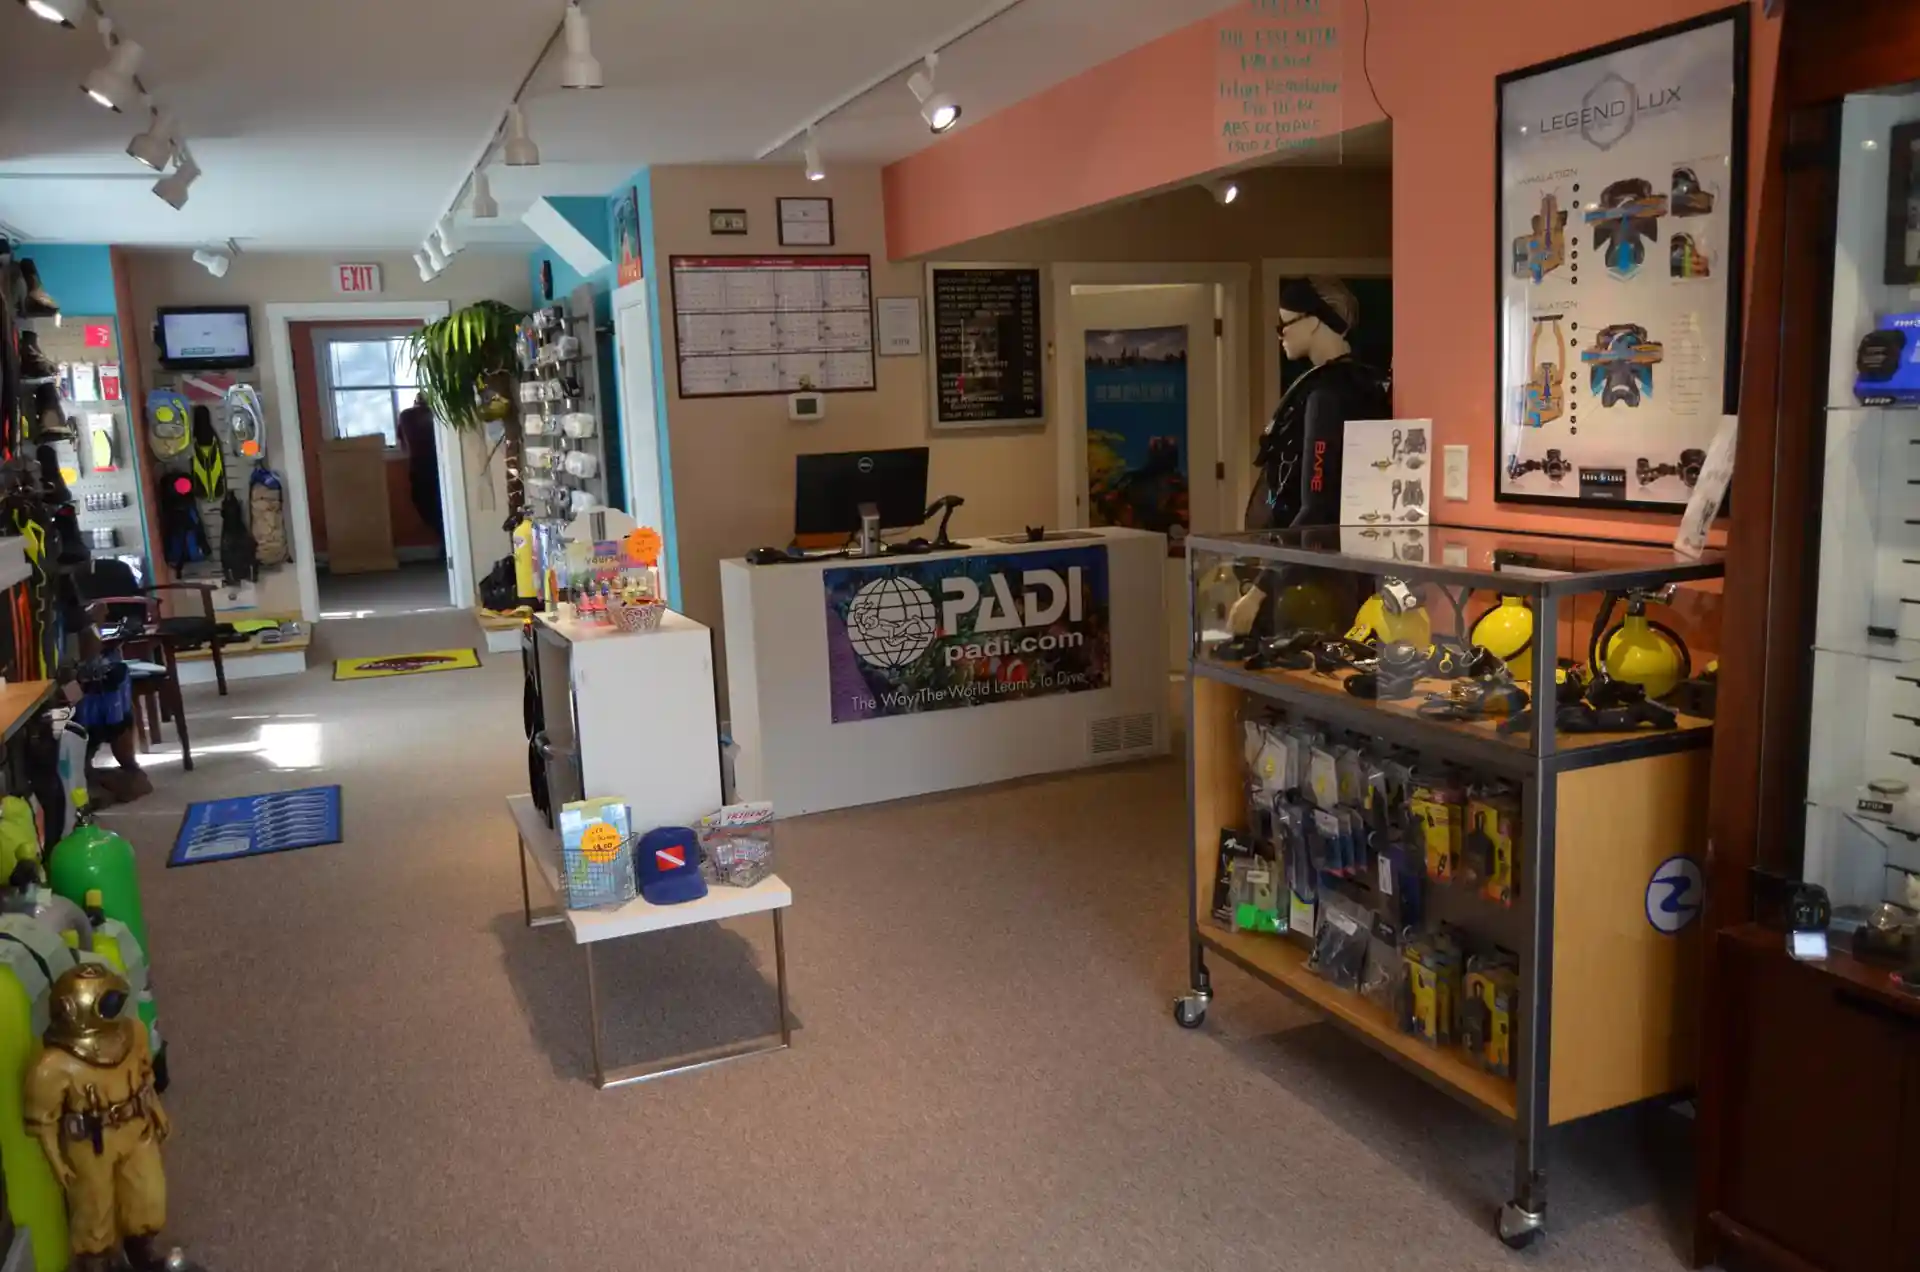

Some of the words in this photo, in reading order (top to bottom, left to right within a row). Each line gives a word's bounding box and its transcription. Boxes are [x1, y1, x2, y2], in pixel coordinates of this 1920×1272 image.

[1540, 99, 1626, 133] LEGEND
[1636, 86, 1682, 111] LUX
[340, 266, 373, 291] EXIT
[1311, 440, 1326, 493] BARE
[941, 566, 1083, 635] PADI
[944, 630, 1083, 667] padi.com
[851, 696, 877, 711] The
[881, 691, 915, 709] Way
[920, 687, 943, 702] The
[949, 682, 990, 698] World
[994, 679, 1035, 694] Learns
[1040, 675, 1053, 687] To
